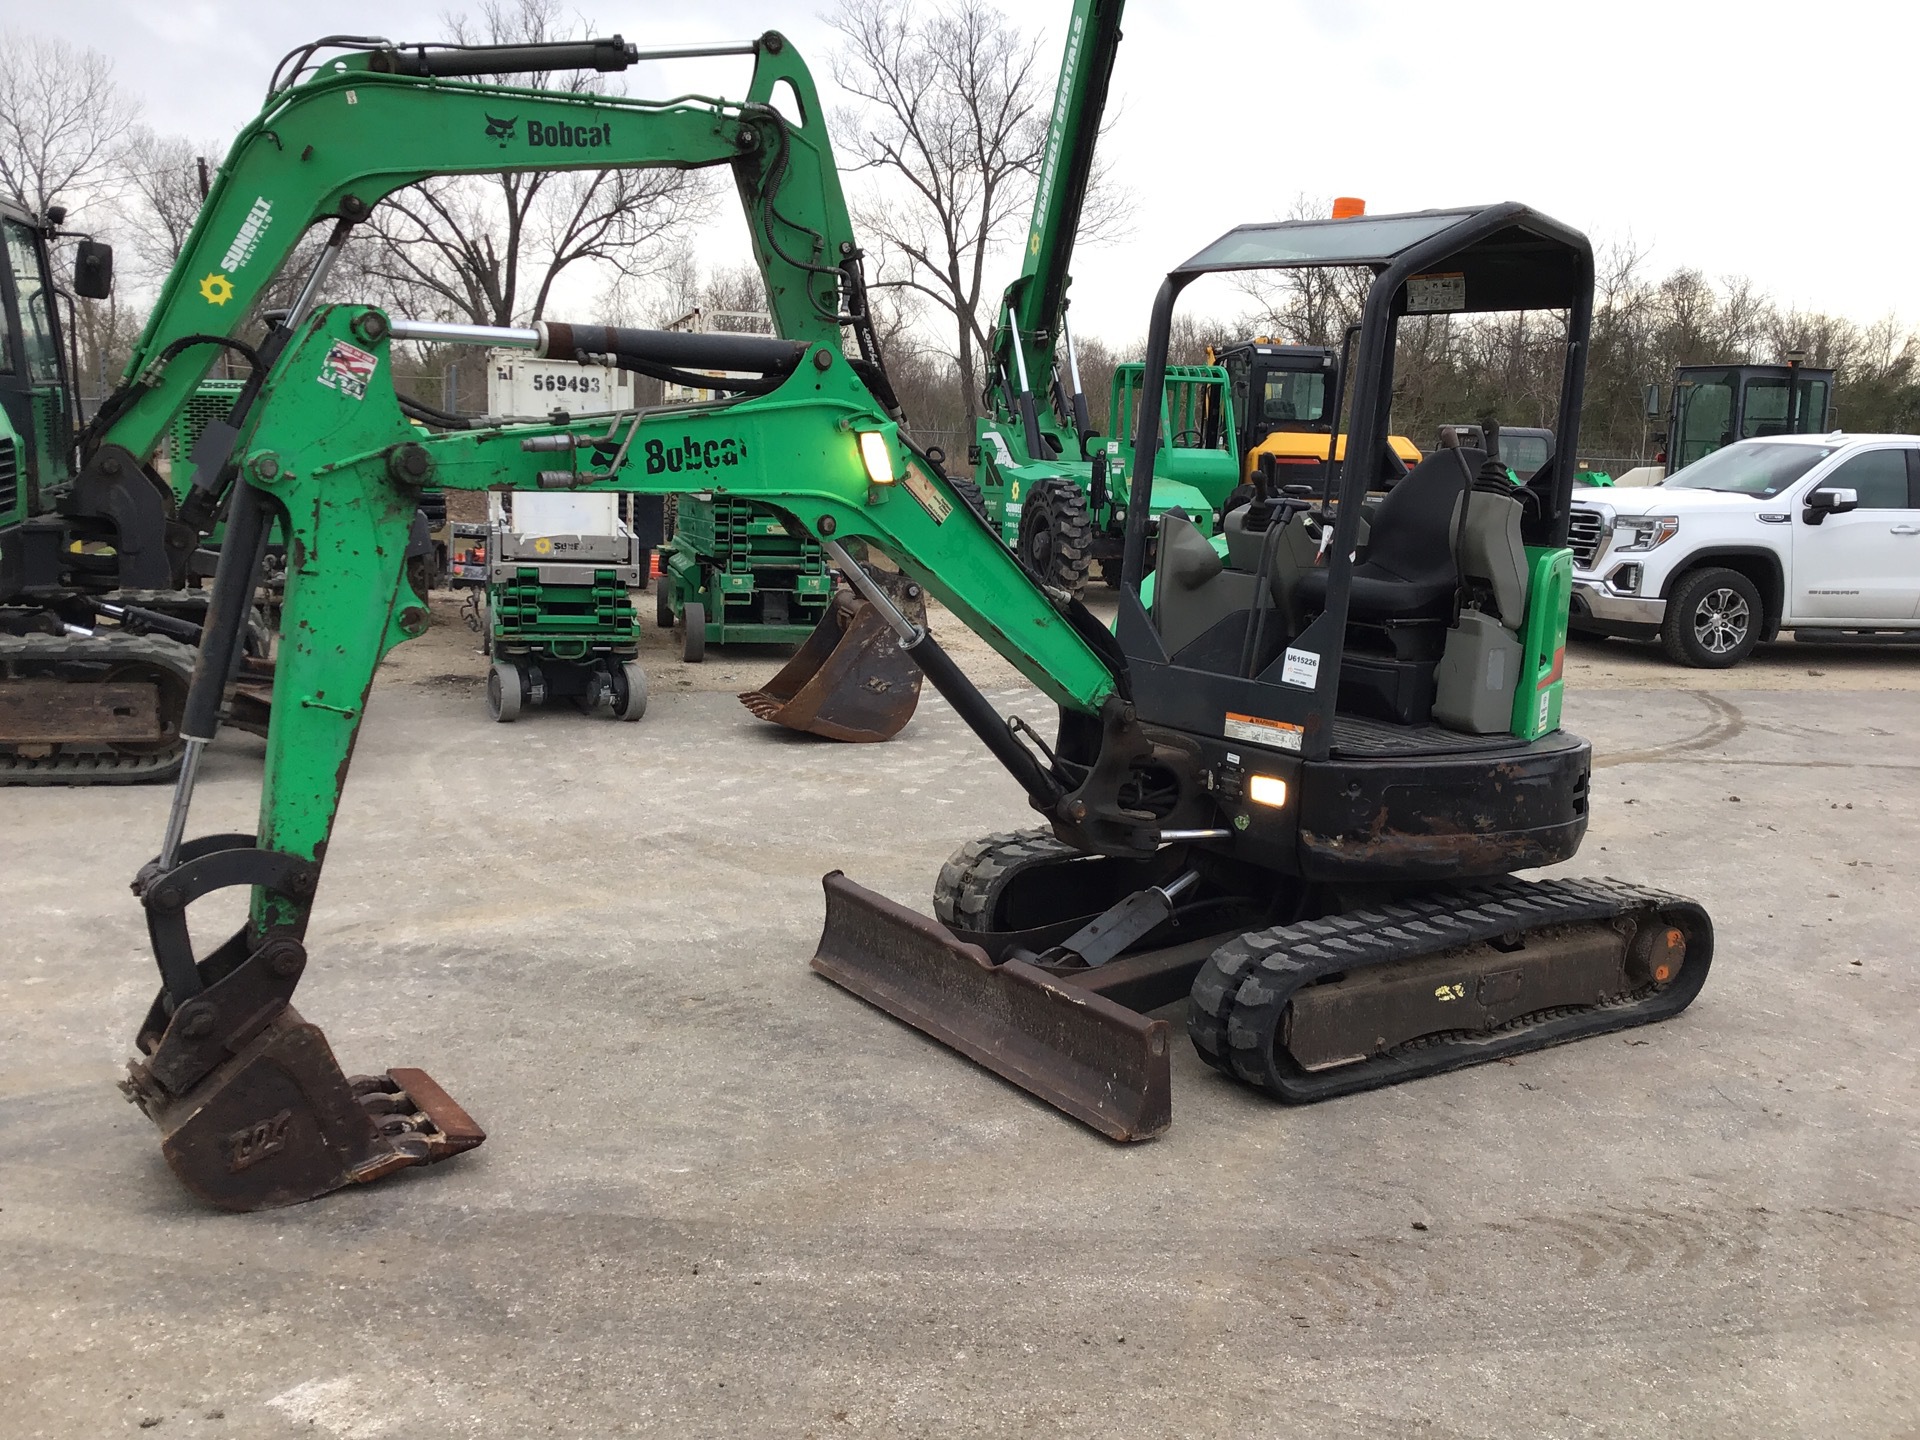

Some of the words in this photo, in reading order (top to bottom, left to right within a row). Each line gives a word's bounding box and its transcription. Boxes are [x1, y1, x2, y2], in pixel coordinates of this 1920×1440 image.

[527, 120, 611, 147] Bobcat
[1035, 125, 1062, 228] SUNBELT
[1056, 14, 1083, 124] RENTALS
[220, 196, 271, 273] SUNBELT
[240, 215, 273, 268] RENTALS
[533, 374, 601, 393] 569493
[1287, 653, 1317, 667] U615226
